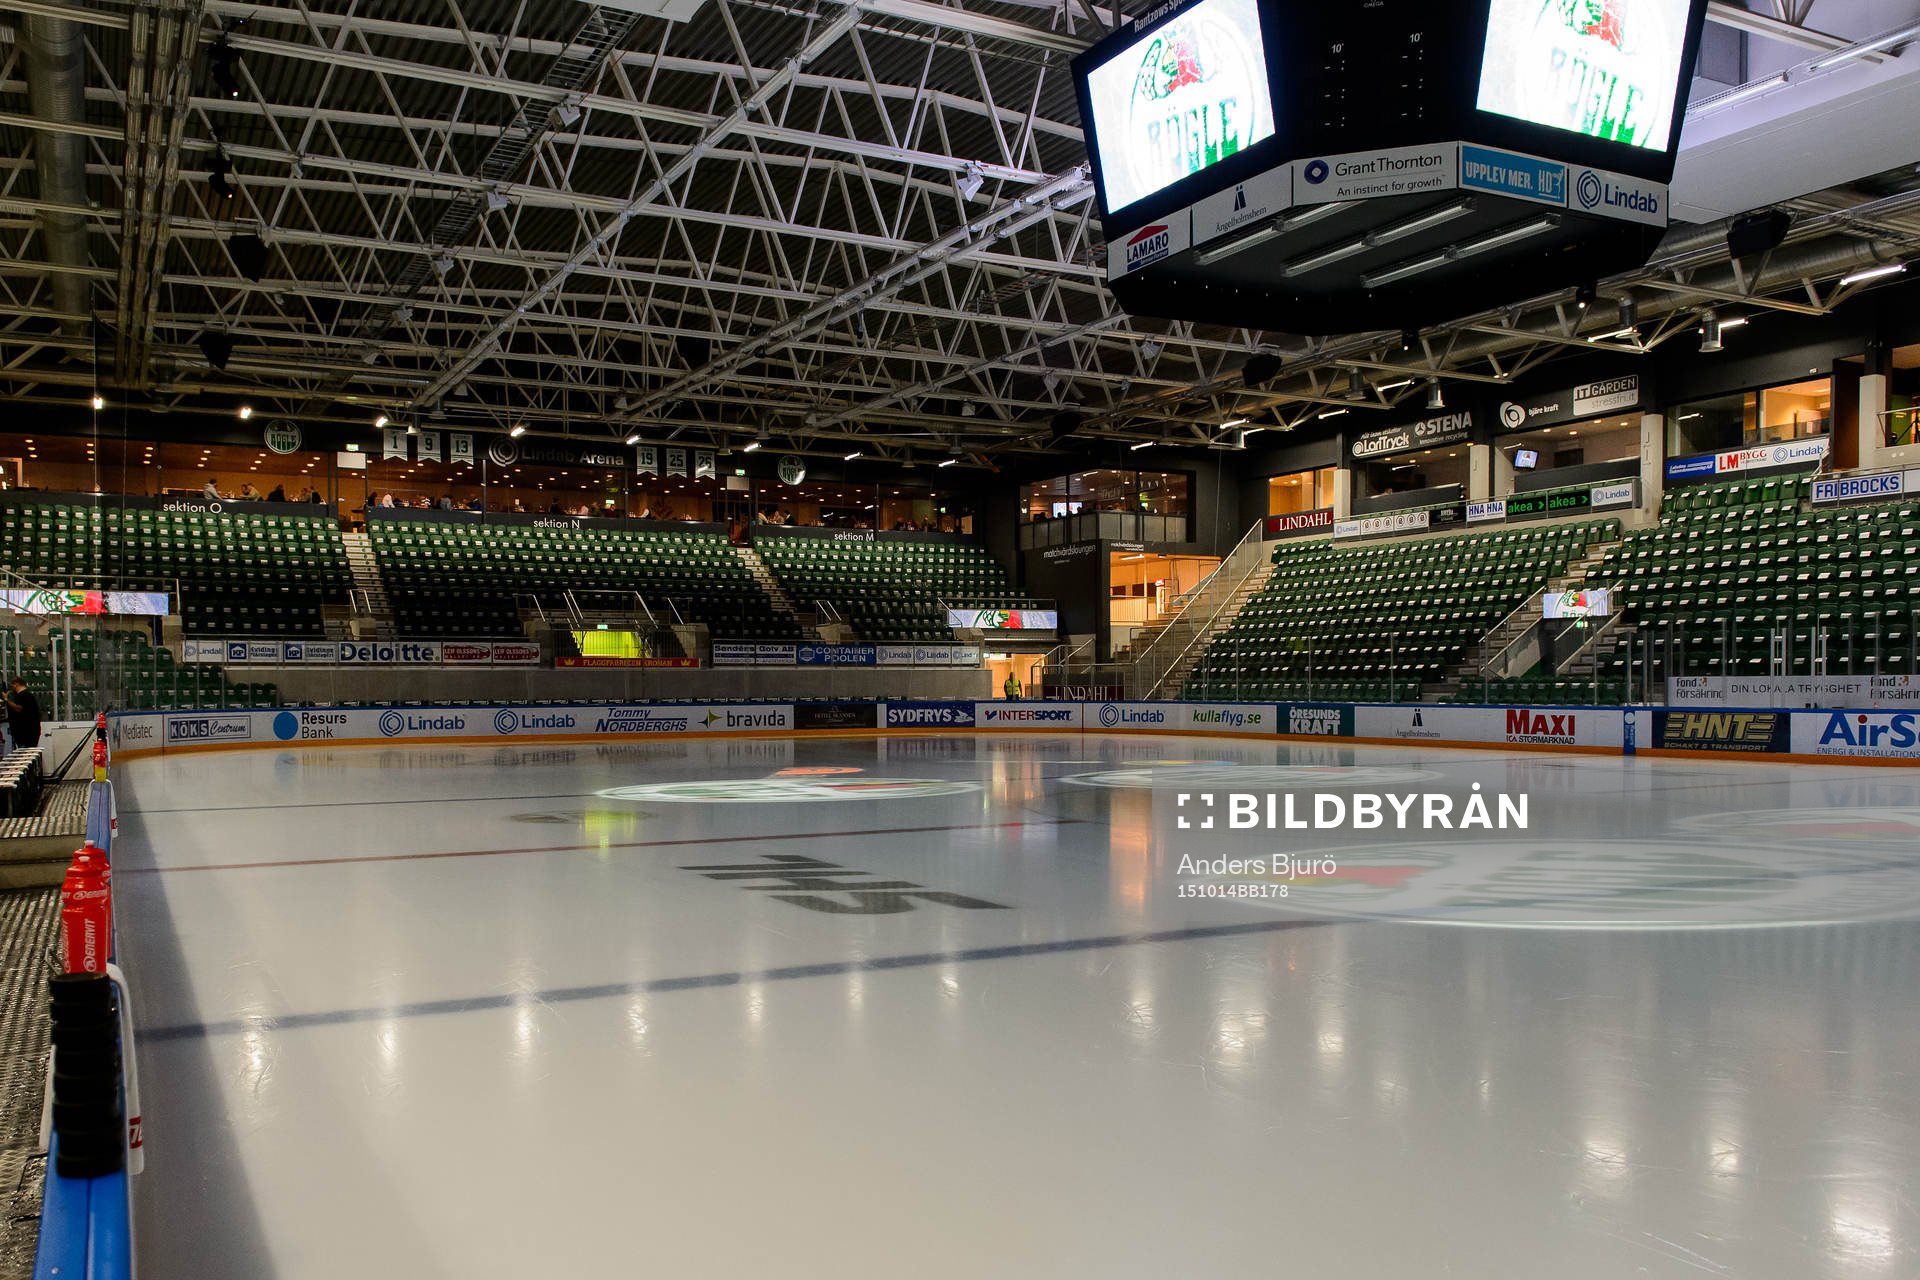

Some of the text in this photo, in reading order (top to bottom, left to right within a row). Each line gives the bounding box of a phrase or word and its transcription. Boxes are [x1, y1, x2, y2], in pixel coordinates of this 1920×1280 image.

[1134, 0, 1186, 33] Rantzows Spo
[1335, 154, 1443, 178] Grant Thornton
[1465, 161, 1507, 184] UPPLEV
[1508, 170, 1534, 190] MER.
[1336, 187, 1351, 197] An
[1353, 182, 1389, 195] instinct
[1391, 180, 1405, 191] for
[1604, 183, 1658, 213] Lindab
[1215, 206, 1267, 232] Ängelholmshem
[1127, 231, 1169, 263] LAMARO
[1574, 387, 1589, 401] IT
[1528, 403, 1559, 417] bjäre kraft
[1427, 410, 1473, 435] STENA
[392, 436, 398, 449] 1
[425, 437, 433, 451] 9
[455, 439, 469, 453] 13
[521, 447, 625, 466] Lindab Arena
[641, 452, 653, 465] 19
[1789, 446, 1824, 458] Lindab
[669, 454, 684, 467] 25
[1719, 452, 1739, 471] LM
[1740, 449, 1767, 459] BYGG
[1605, 488, 1630, 500] Lindab
[163, 501, 222, 514] sektion O
[1468, 504, 1485, 515] HNA
[1486, 502, 1503, 513] HNA
[1507, 502, 1533, 514] akea
[1550, 496, 1576, 509] akea
[533, 518, 580, 529] sektion N
[1279, 512, 1332, 531] LINDAHL
[834, 531, 875, 541] sektion M
[815, 647, 875, 655] CONTAINER
[926, 651, 949, 659] Lindab
[1055, 686, 1112, 701] LINDAHL
[1731, 684, 1749, 694] DIN
[1753, 684, 1795, 694] LOKAA
[301, 711, 347, 725] Resurs
[607, 707, 651, 720] Tommy
[726, 709, 786, 727] bravida
[888, 708, 952, 723] SYDFRYS
[999, 710, 1072, 721] INTERSPORT
[1122, 708, 1164, 723] Lindab
[1192, 709, 1262, 727] kullaflyg.se
[1288, 706, 1341, 720] ÖRESUNDS
[209, 720, 246, 736] Centrum
[407, 714, 465, 731] Lindab
[521, 713, 575, 729] Lindab
[595, 718, 688, 732] NORDBERGHS
[1289, 719, 1341, 736] KRAFT
[1506, 709, 1576, 736] MAXI
[122, 723, 153, 740] Mediatec
[301, 726, 334, 739] Bank
[1819, 711, 1920, 748] AirS
[1518, 735, 1576, 745] STORMARKNAD
[1664, 742, 1700, 750] SCHAKT
[1711, 743, 1768, 751] TRANSPORT
[1817, 747, 1847, 756] ENERGI
[1848, 748, 1856, 756] &
[84, 918, 96, 957] ENERVIT
